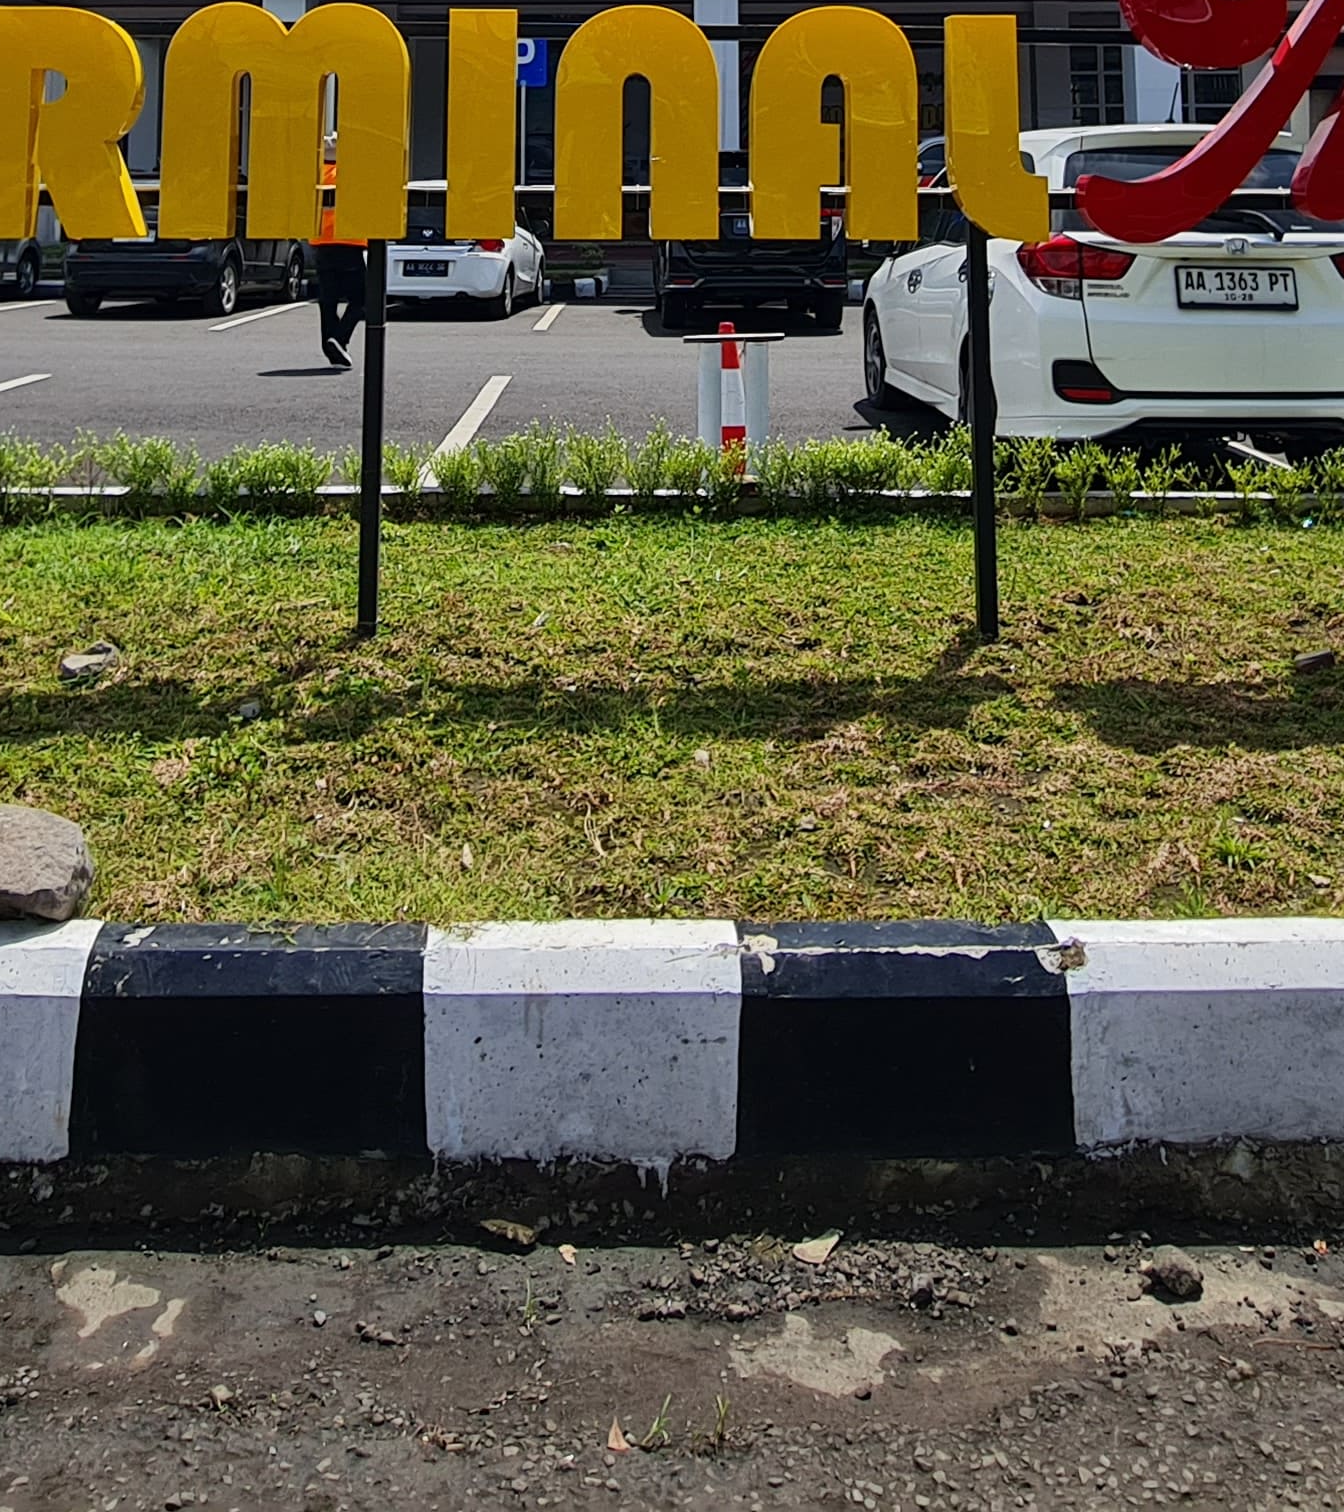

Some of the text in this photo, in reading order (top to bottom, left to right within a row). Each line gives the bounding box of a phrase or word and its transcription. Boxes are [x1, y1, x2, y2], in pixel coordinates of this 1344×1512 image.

[1184, 271, 1291, 293] AA 1363 PT
